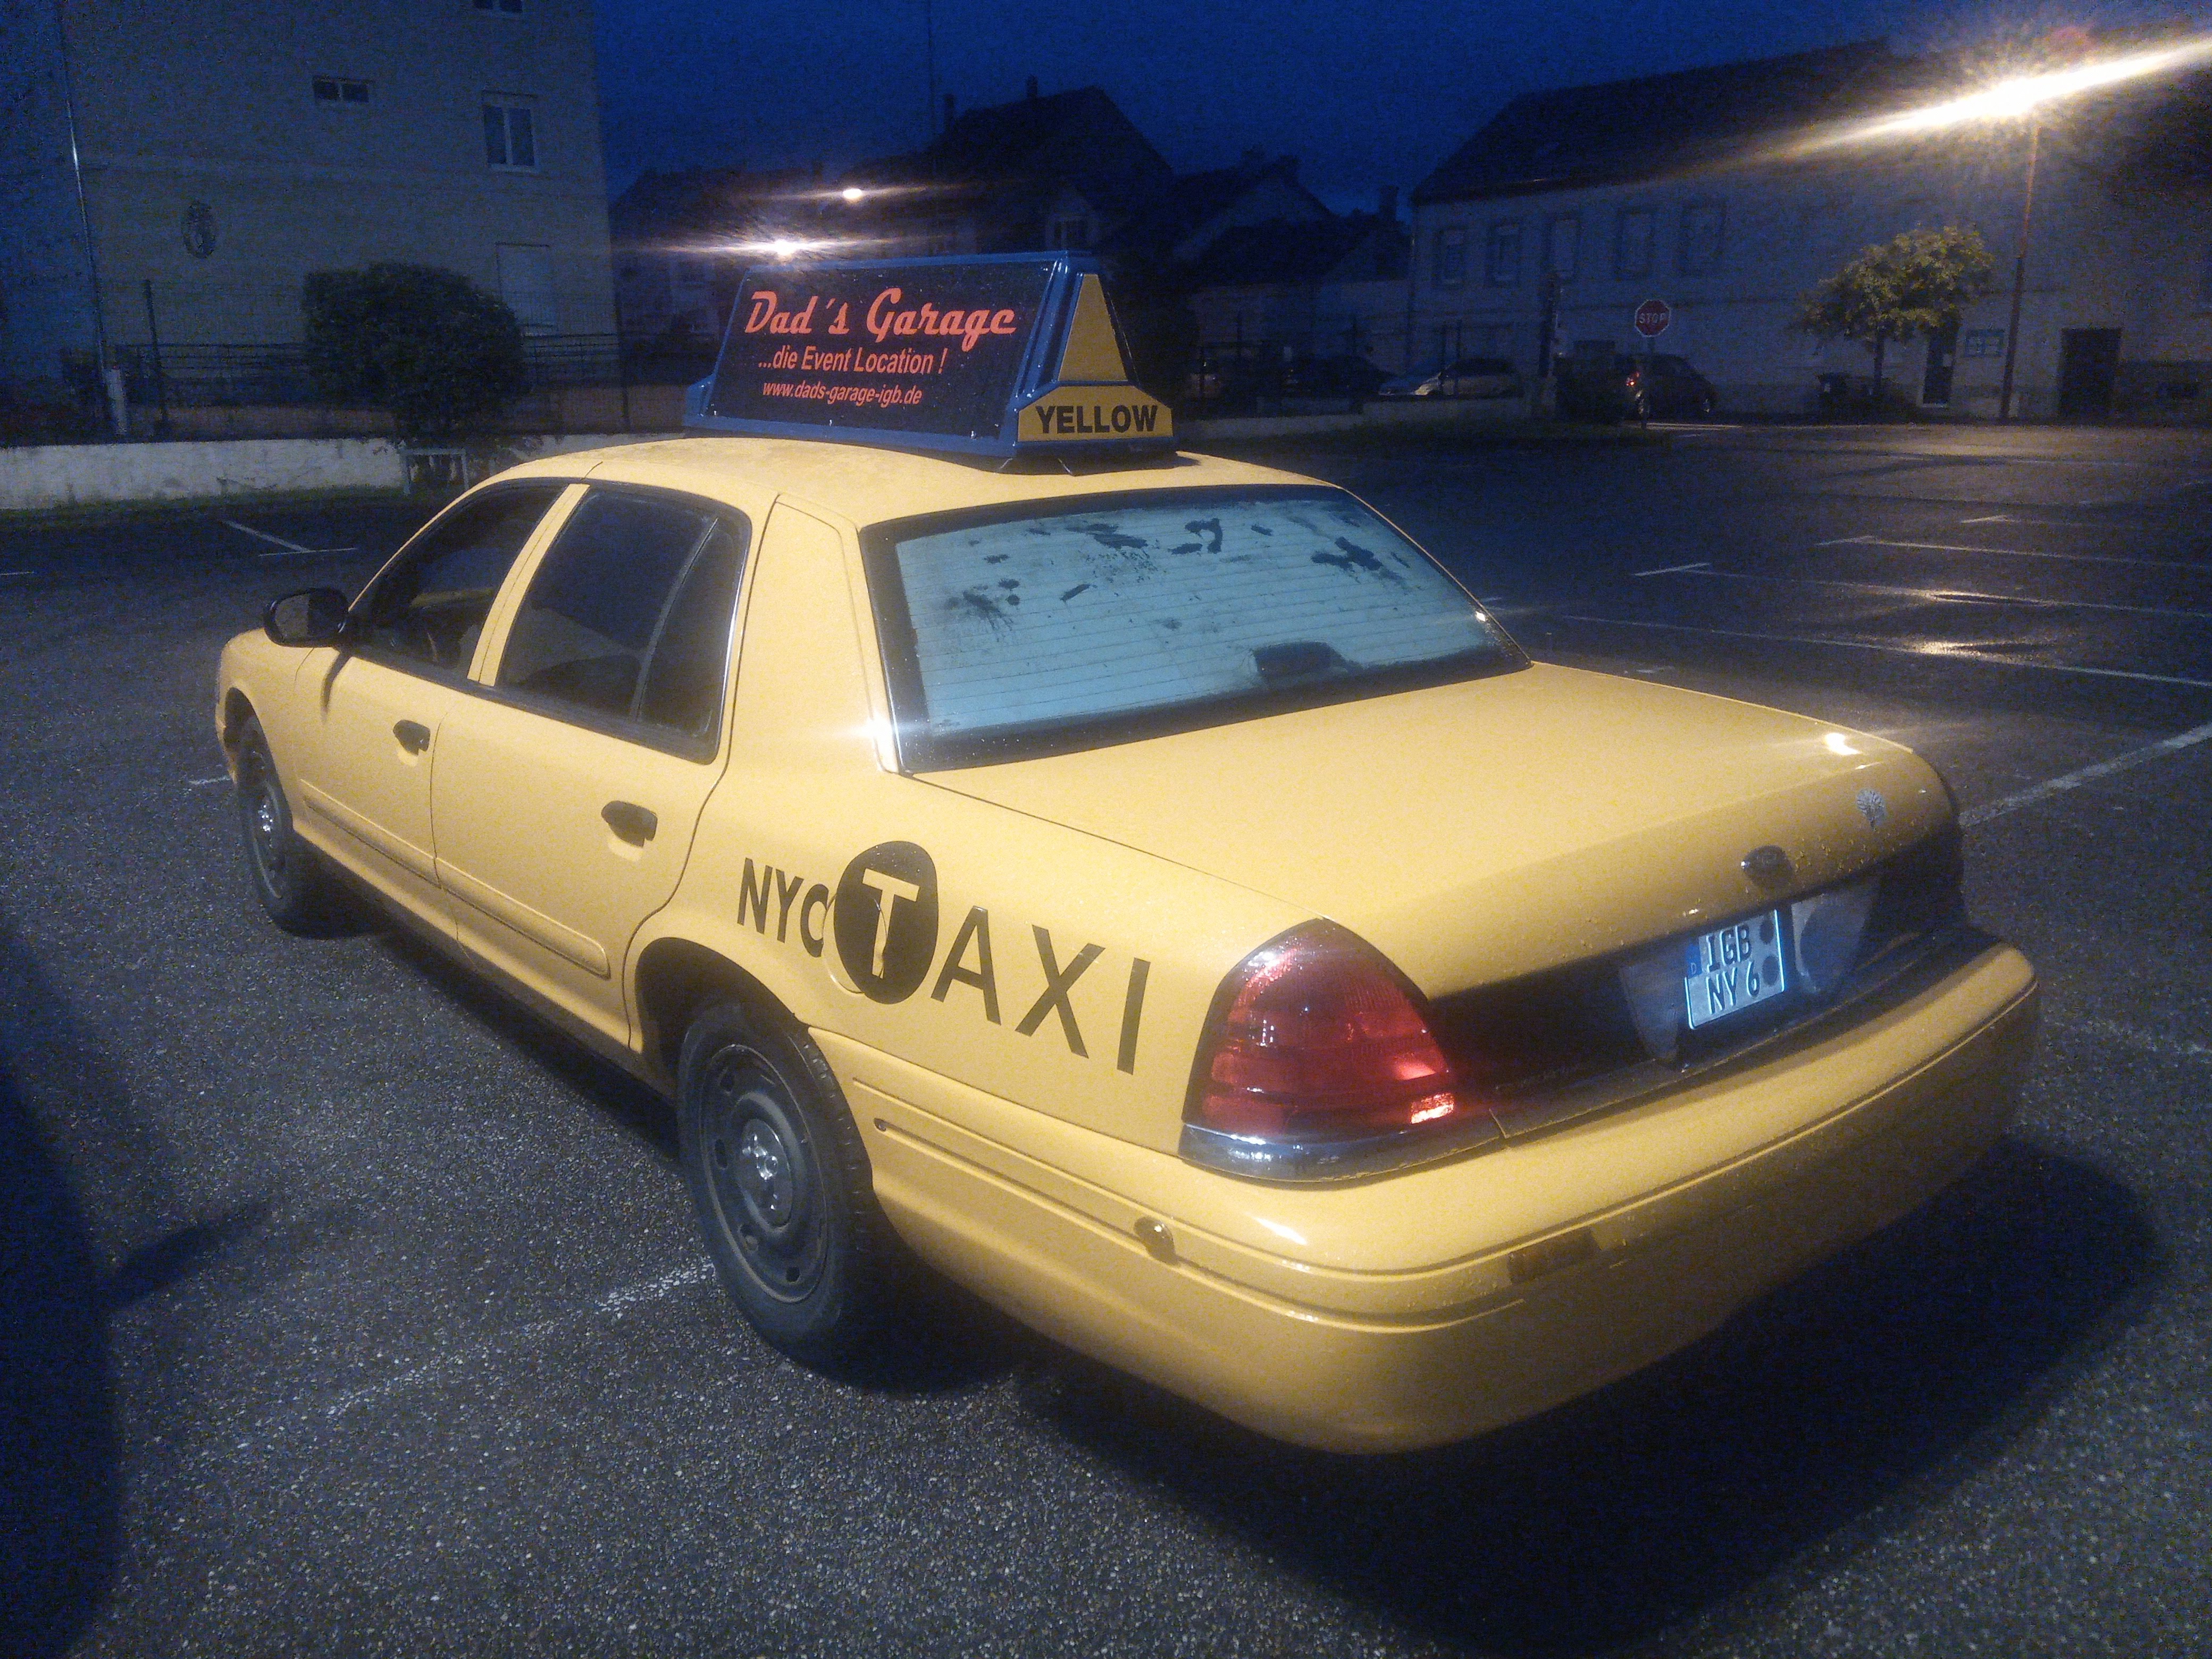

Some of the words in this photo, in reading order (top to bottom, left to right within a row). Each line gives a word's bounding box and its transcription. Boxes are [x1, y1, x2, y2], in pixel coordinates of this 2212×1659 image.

[867, 288, 1016, 351] Garage
[1639, 313, 1666, 324] STOP
[759, 345, 798, 369] ...die
[801, 346, 852, 372] Event
[853, 347, 934, 374] Location
[763, 380, 922, 408] www.dads-garage-igb.de
[1035, 405, 1157, 433] YELLOW
[737, 858, 828, 957] NYC
[1706, 925, 1752, 973] IGB
[1706, 967, 1738, 1013] NY
[1746, 961, 1760, 998] 6
